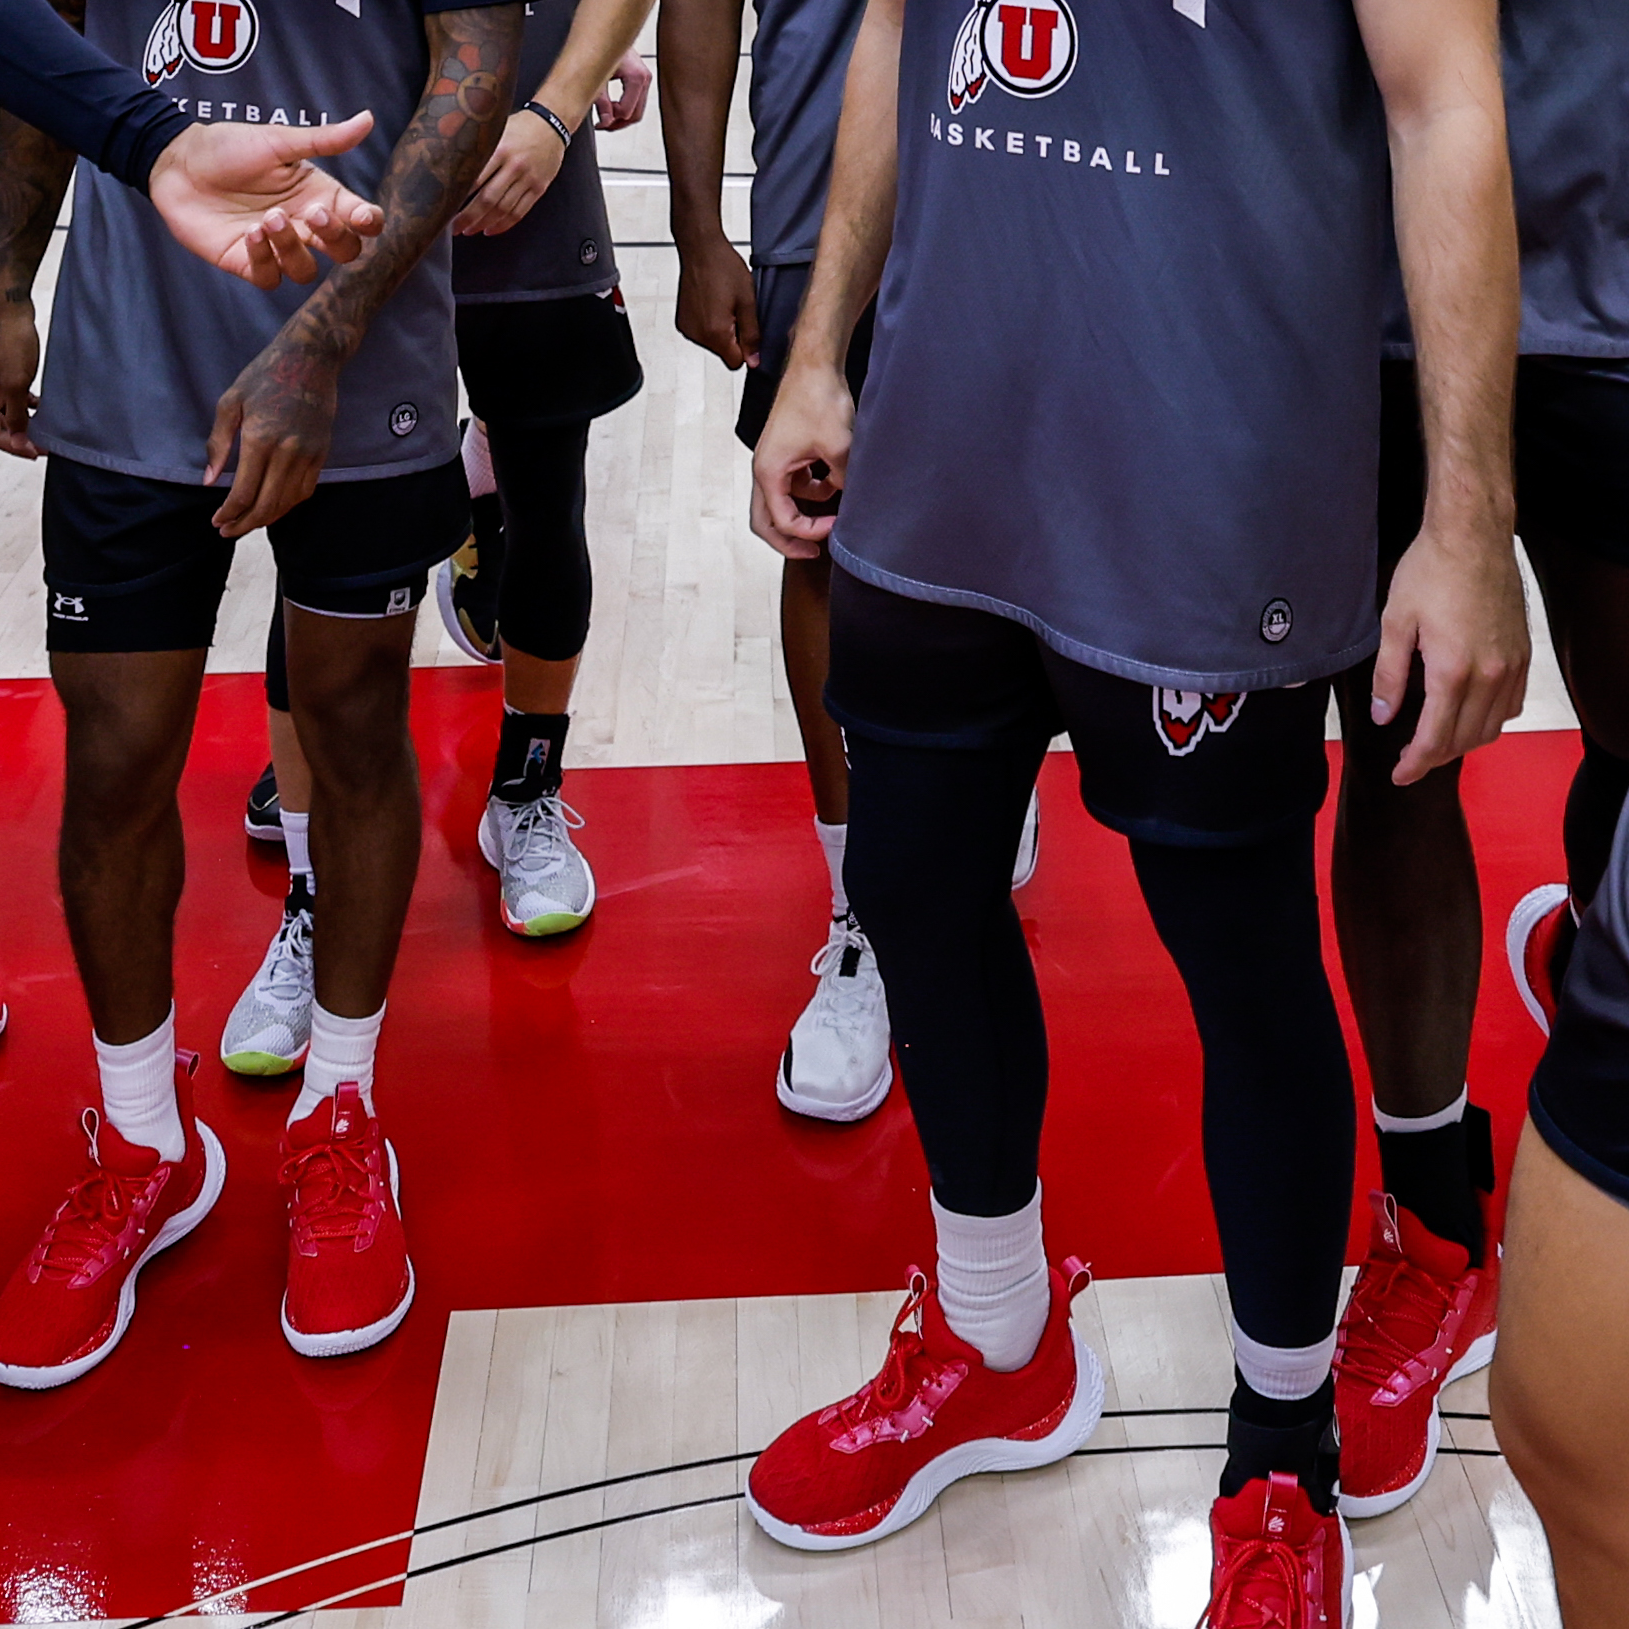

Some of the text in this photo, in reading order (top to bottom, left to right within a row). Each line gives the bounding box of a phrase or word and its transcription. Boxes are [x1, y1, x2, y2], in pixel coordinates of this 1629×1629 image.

[192, 2, 241, 59] U
[997, 3, 1059, 80] U
[1272, 612, 1285, 624] XL
